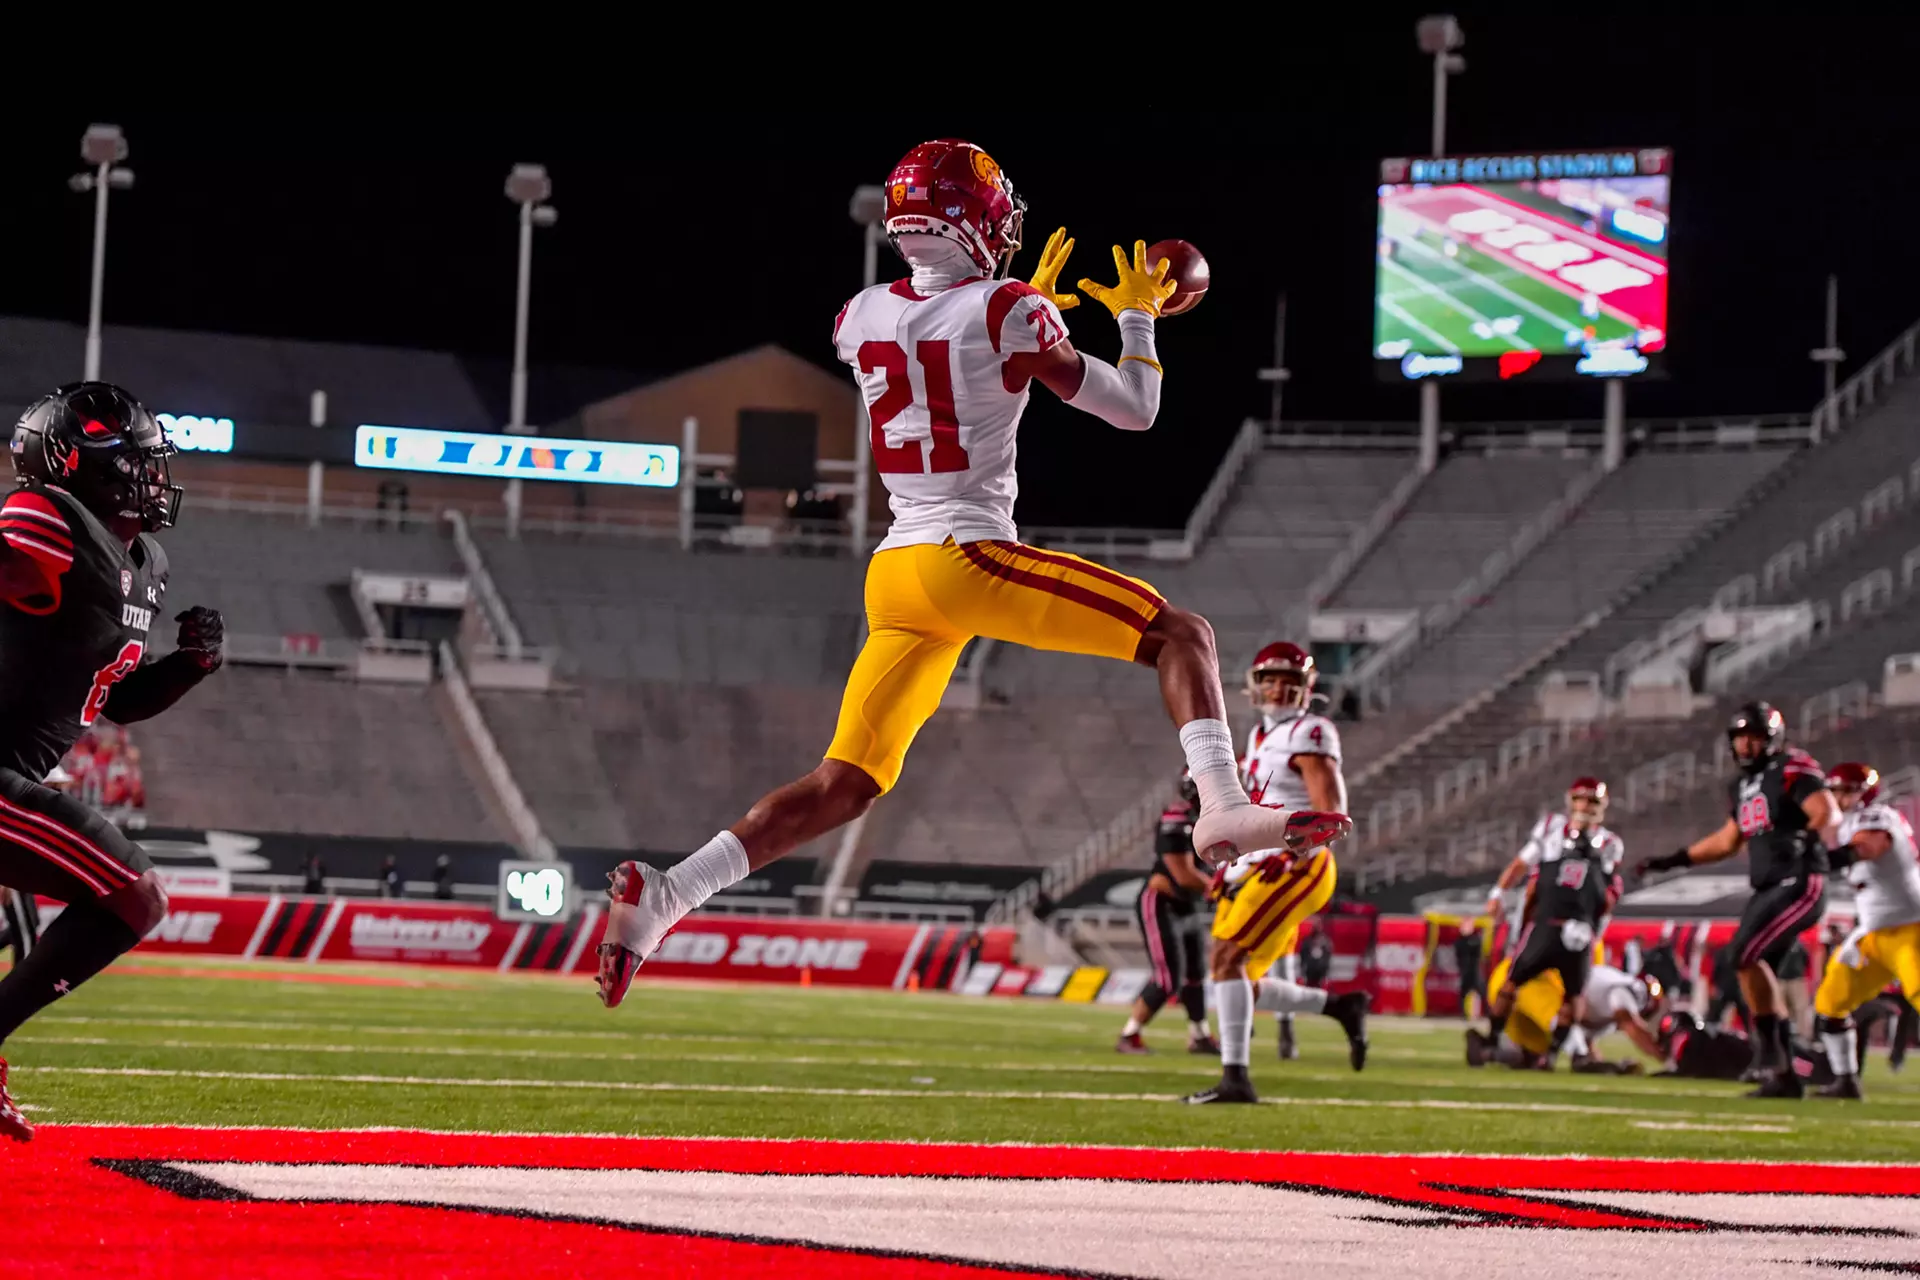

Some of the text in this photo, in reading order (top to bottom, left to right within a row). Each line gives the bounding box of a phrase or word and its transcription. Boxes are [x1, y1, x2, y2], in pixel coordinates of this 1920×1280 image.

[1026, 303, 1064, 352] 21
[857, 340, 970, 474] 21
[122, 603, 151, 632] UTAH
[1309, 725, 1323, 749] 4
[507, 869, 563, 915] 40
[648, 931, 867, 970] ED ZONE
